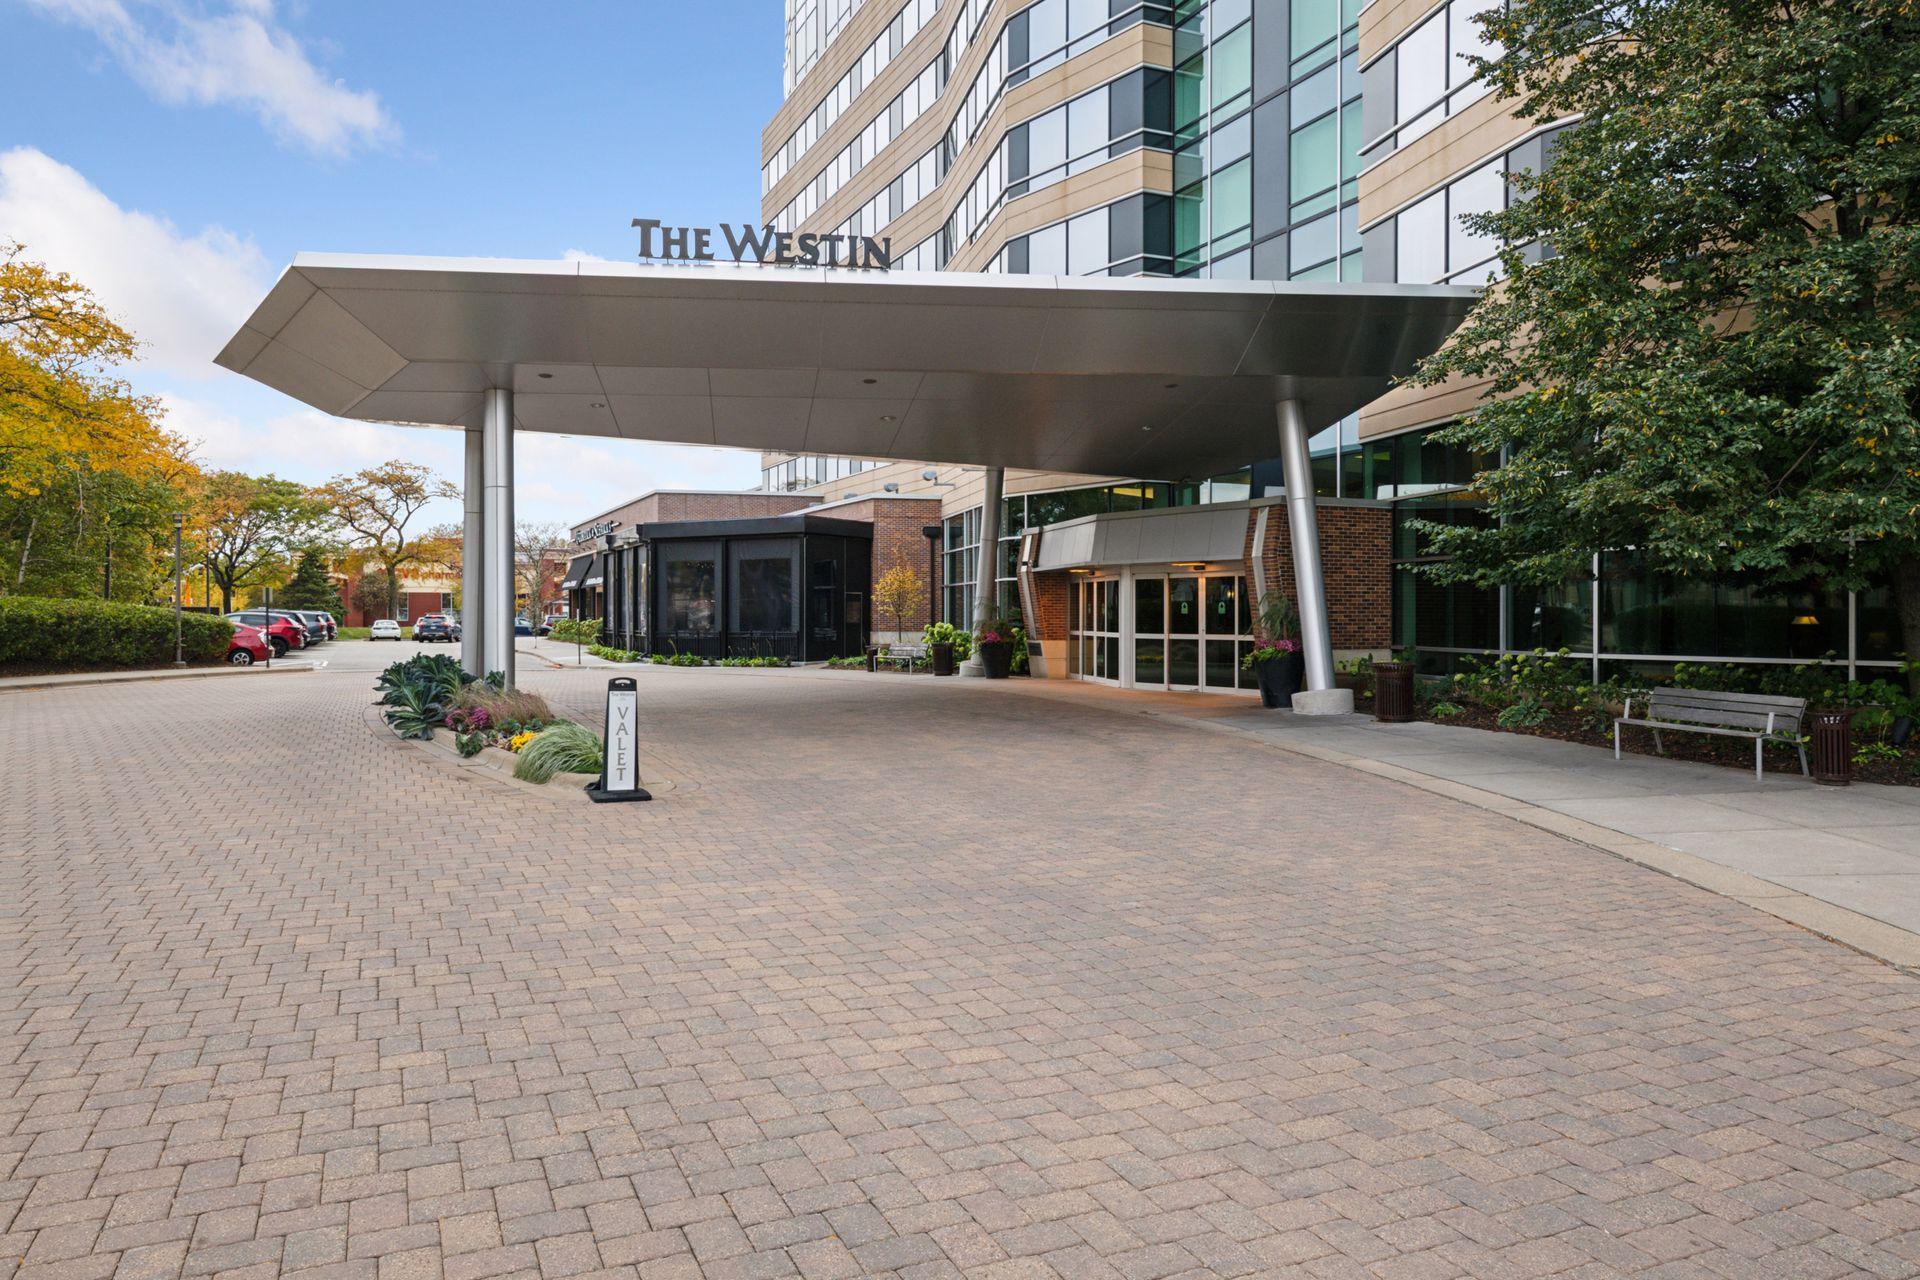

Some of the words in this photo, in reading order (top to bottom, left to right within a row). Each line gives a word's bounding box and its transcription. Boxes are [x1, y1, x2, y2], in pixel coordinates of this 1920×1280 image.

[631, 218, 715, 260] THE
[719, 223, 892, 269] WESTIN
[615, 706, 629, 781] VALET
